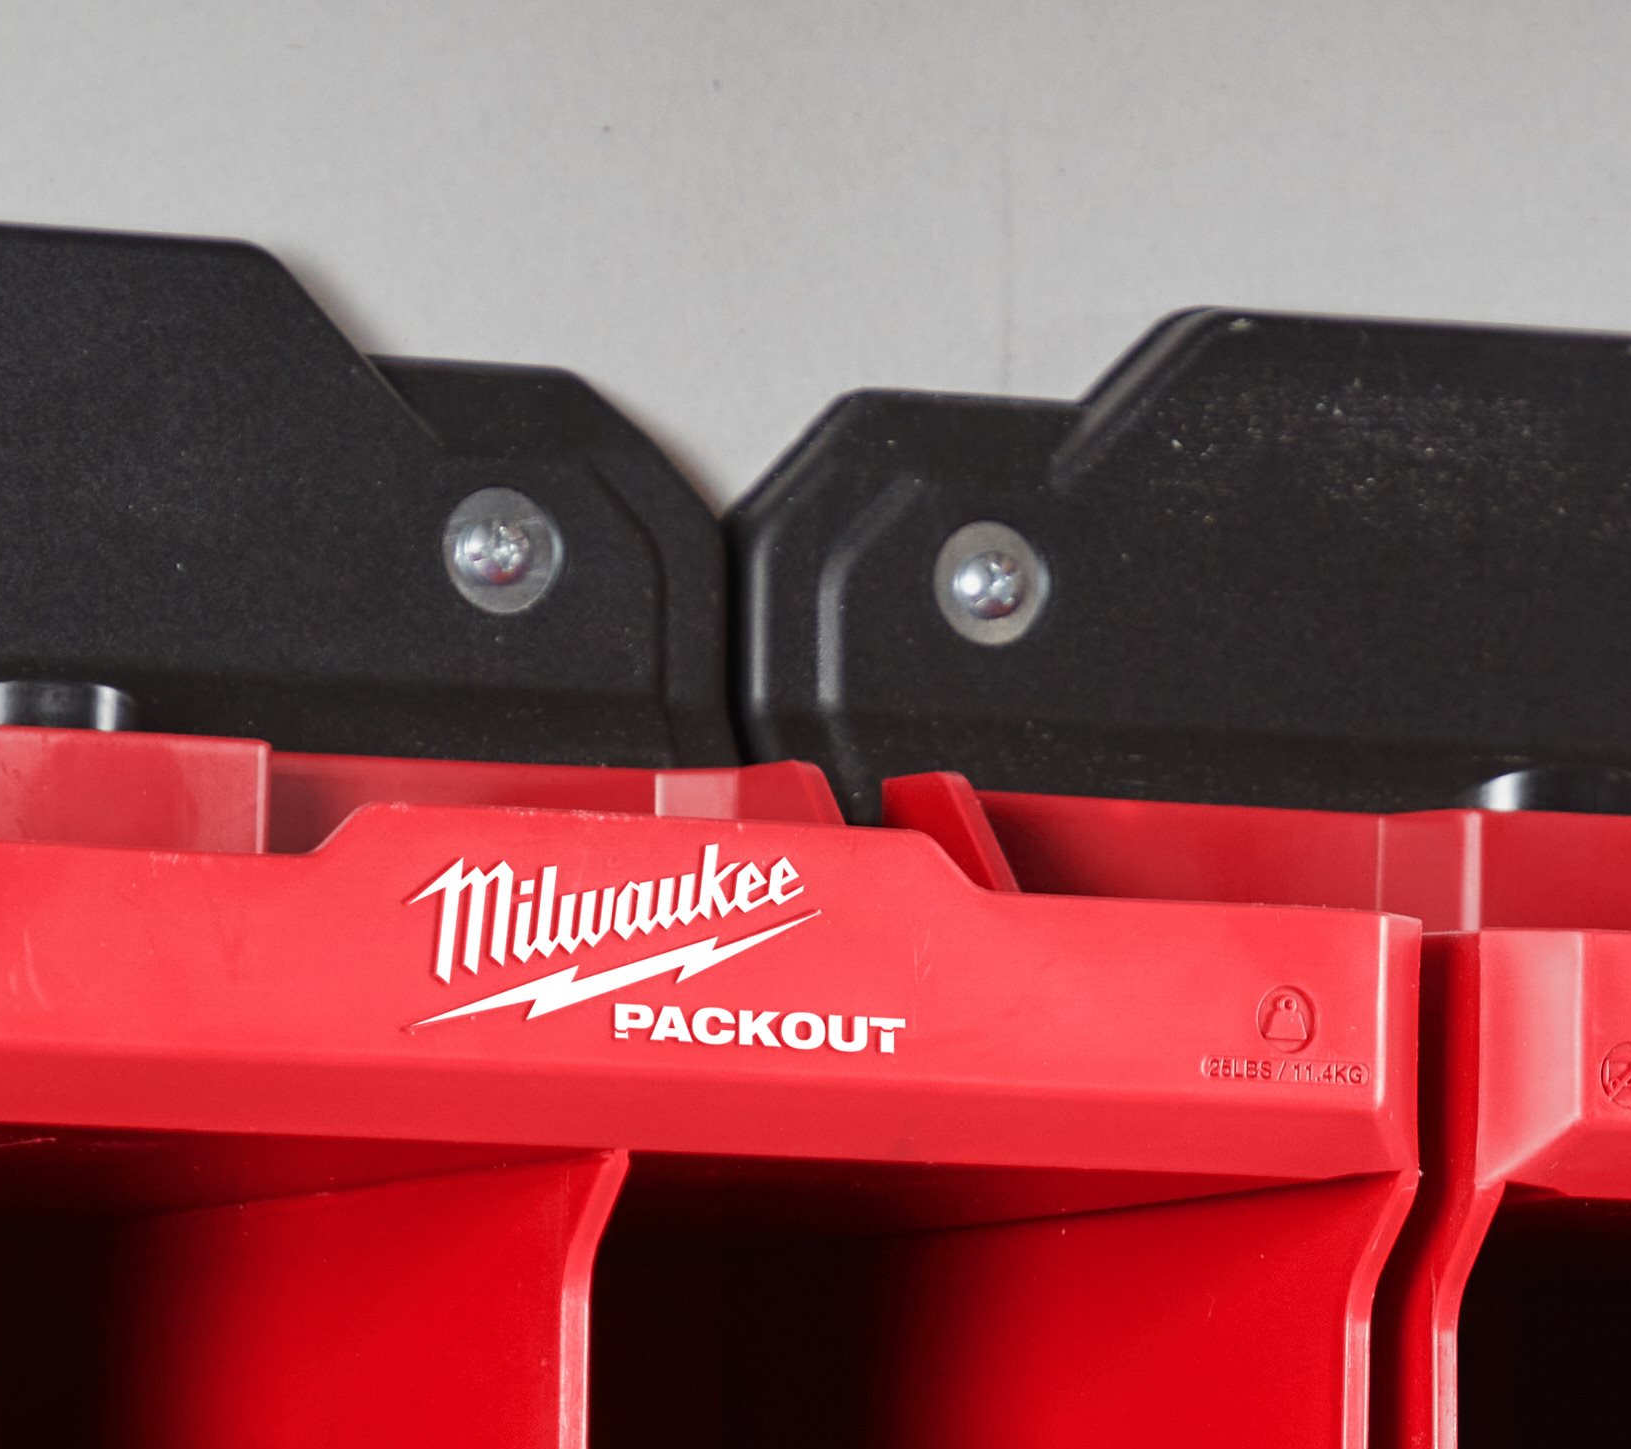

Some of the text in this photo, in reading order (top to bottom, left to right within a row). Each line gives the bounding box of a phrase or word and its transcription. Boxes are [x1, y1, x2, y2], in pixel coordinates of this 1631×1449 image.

[406, 842, 805, 985] Milwaukee
[613, 1001, 907, 1054] PACKOUT
[1208, 1058, 1272, 1080] 25LBS
[1292, 1062, 1363, 1084] 11.4KG
